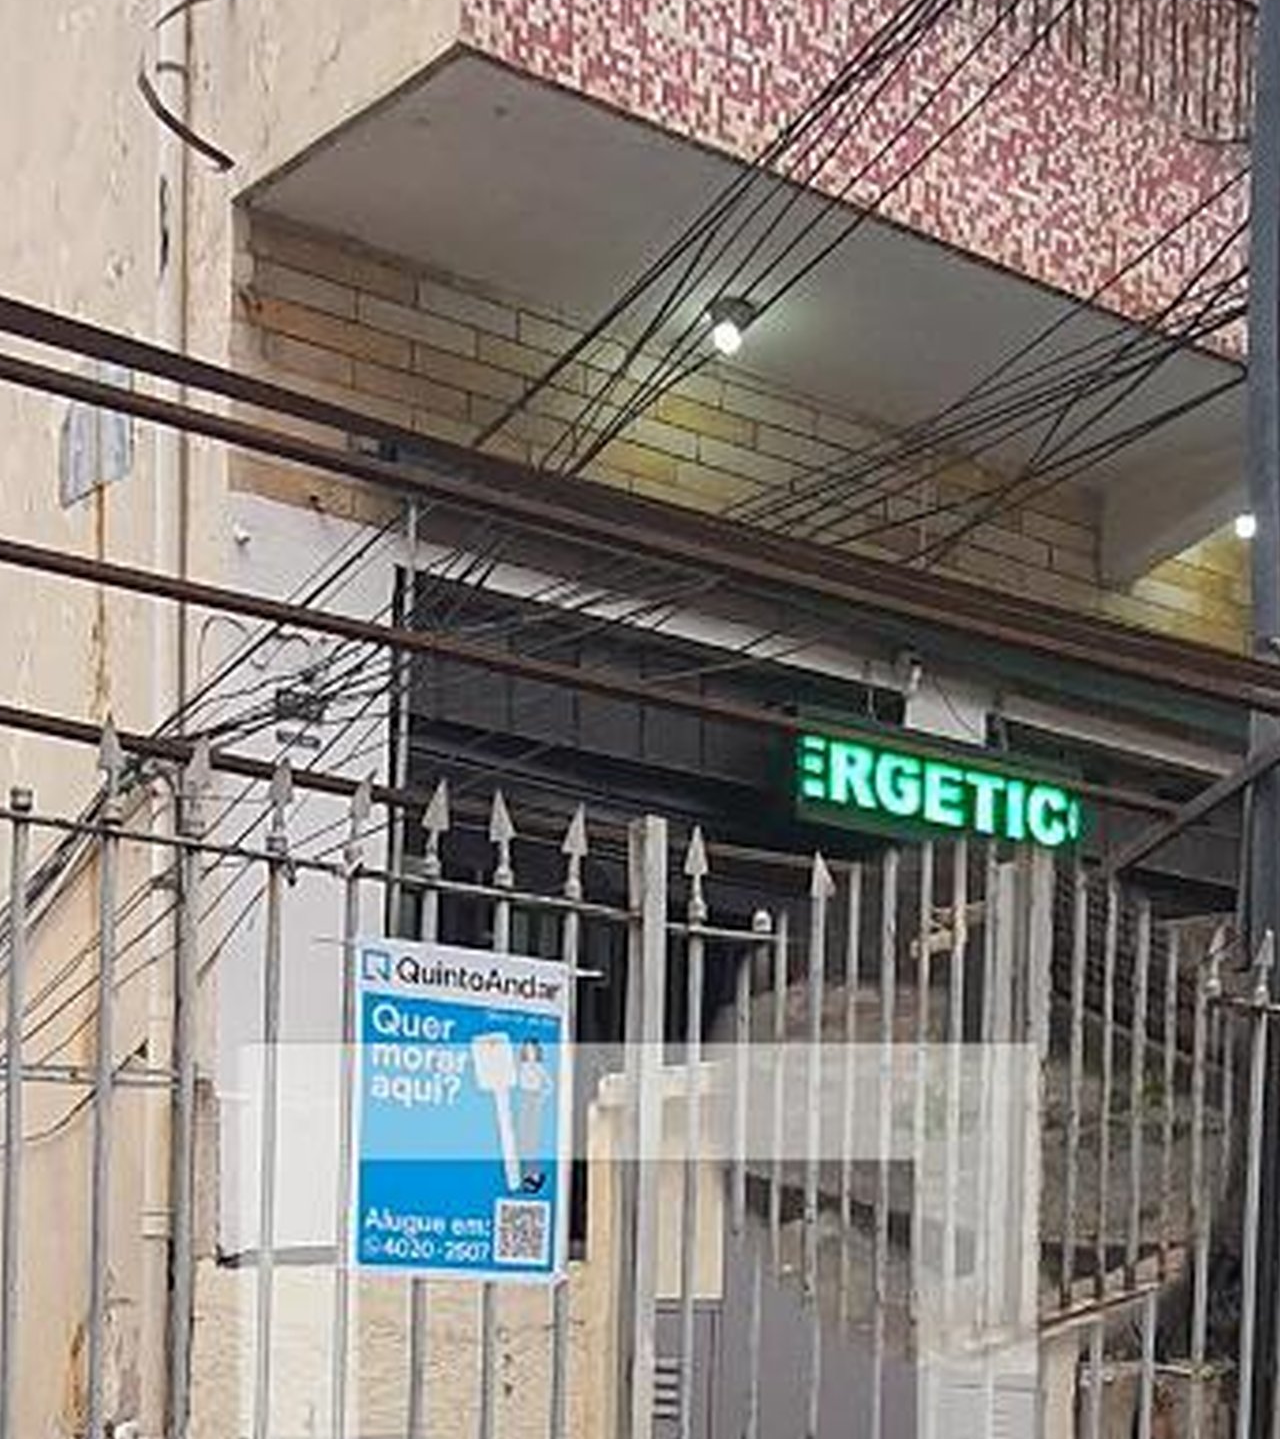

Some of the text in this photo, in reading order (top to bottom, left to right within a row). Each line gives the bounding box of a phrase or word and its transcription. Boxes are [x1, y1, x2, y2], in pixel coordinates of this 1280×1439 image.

[396, 956, 561, 1000] QuintoAndar
[372, 1003, 455, 1041] Quer
[371, 1042, 467, 1074] morar
[371, 1074, 461, 1107] aqui?
[365, 1208, 491, 1238] Alugue em:
